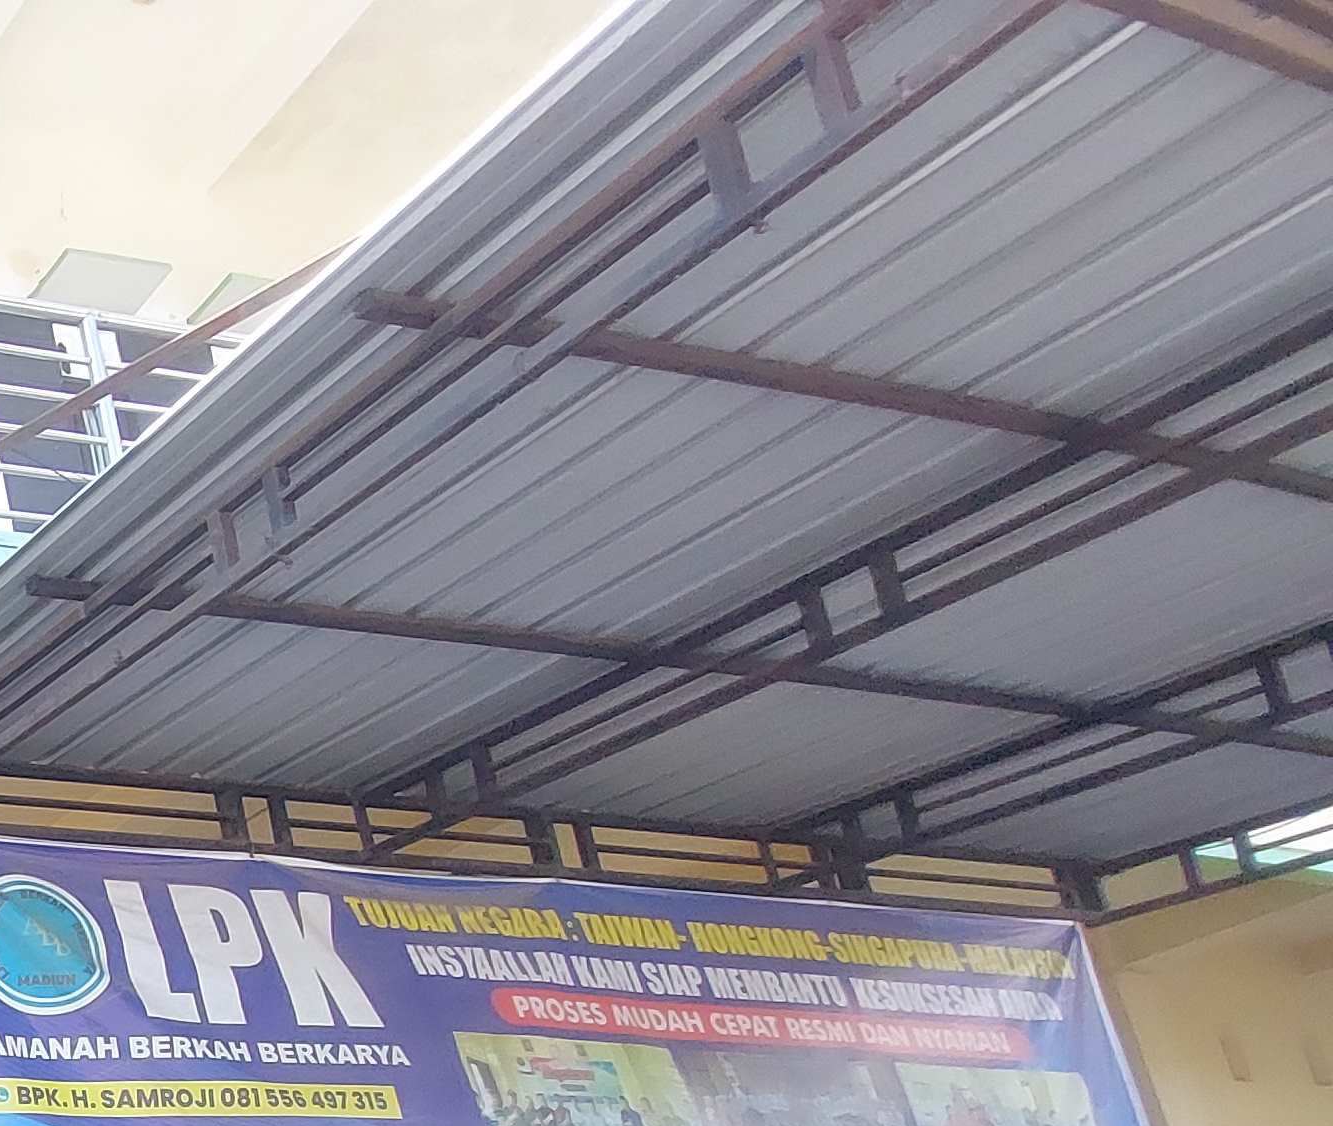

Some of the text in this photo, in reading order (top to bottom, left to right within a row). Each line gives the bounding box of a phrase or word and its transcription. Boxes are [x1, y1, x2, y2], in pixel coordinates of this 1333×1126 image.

[343, 896, 457, 933] TUJUAN
[457, 905, 568, 940] NEGARA
[103, 879, 386, 1028] LPK
[405, 944, 575, 986] INSYAALLAH
[570, 955, 643, 993] KAMI
[641, 962, 703, 997] SIAP
[703, 967, 848, 1007] MEMBANTU
[849, 976, 999, 1017] KESUKSESAN
[512, 995, 1013, 1053] PROSES MUDAH CEPAT RESMI DAN NYAMAN
[129, 1035, 253, 1063] BERKAH
[257, 1041, 413, 1067] BERKARYA
[16, 1086, 389, 1111] BPK. H. SAMROJI 081 556 497 315
